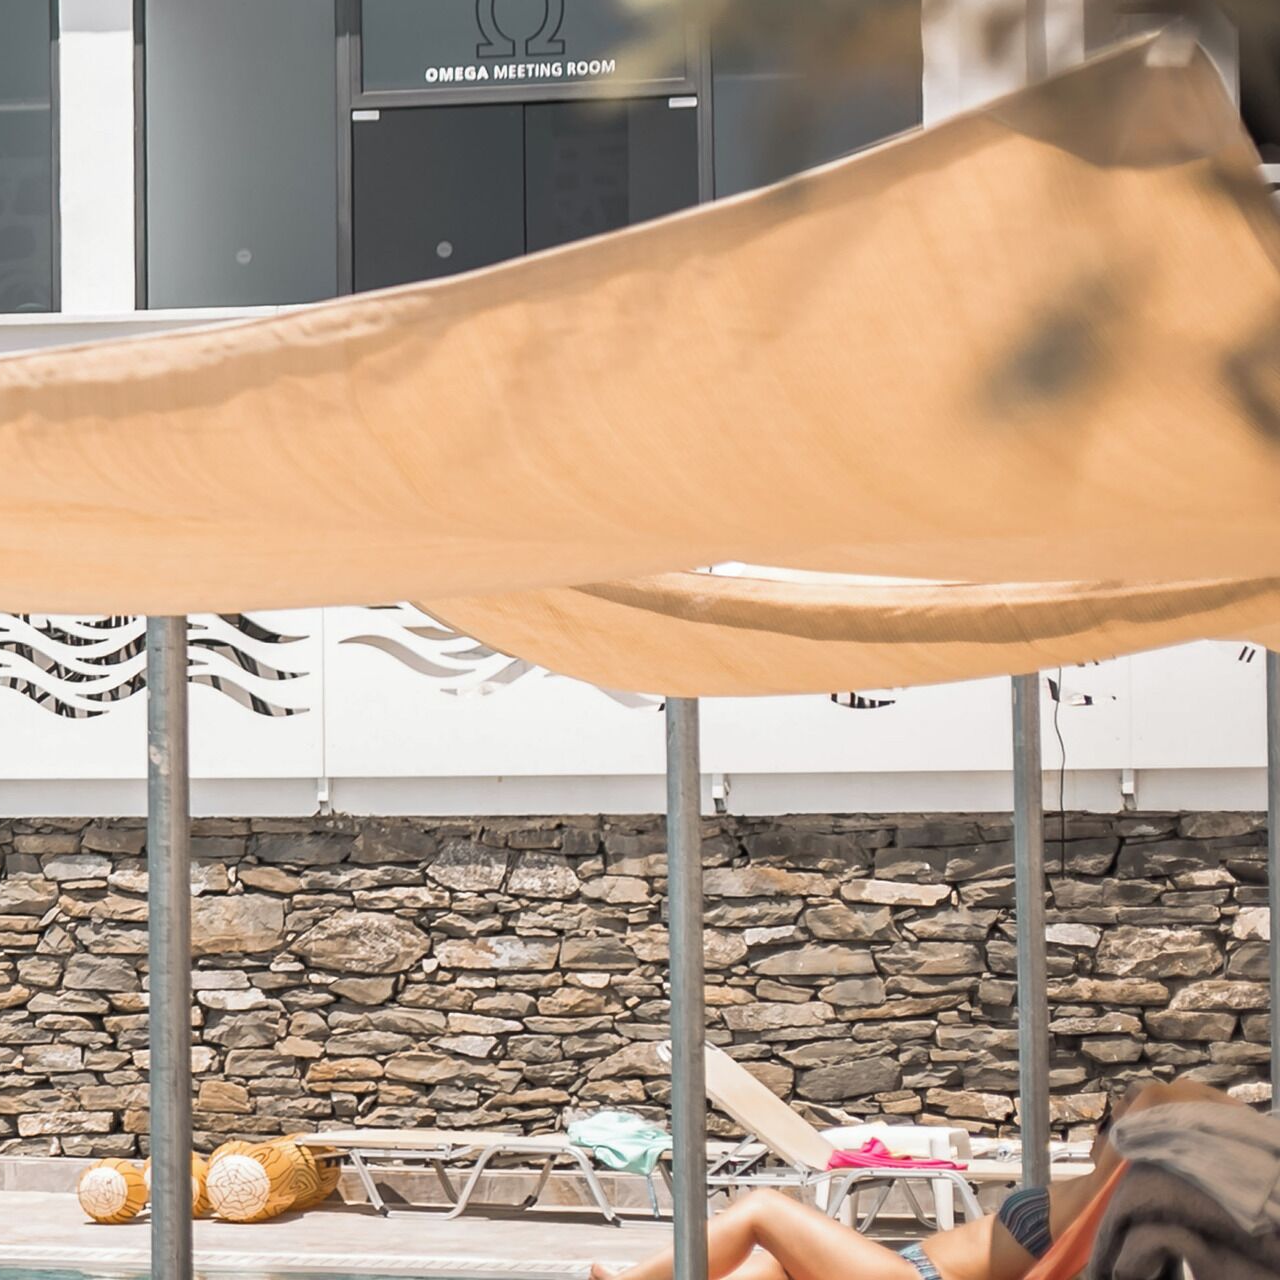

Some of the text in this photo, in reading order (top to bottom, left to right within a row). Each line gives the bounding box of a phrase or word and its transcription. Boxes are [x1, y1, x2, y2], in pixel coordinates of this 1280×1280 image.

[425, 59, 616, 82] OMEGA MEETING ROOM
